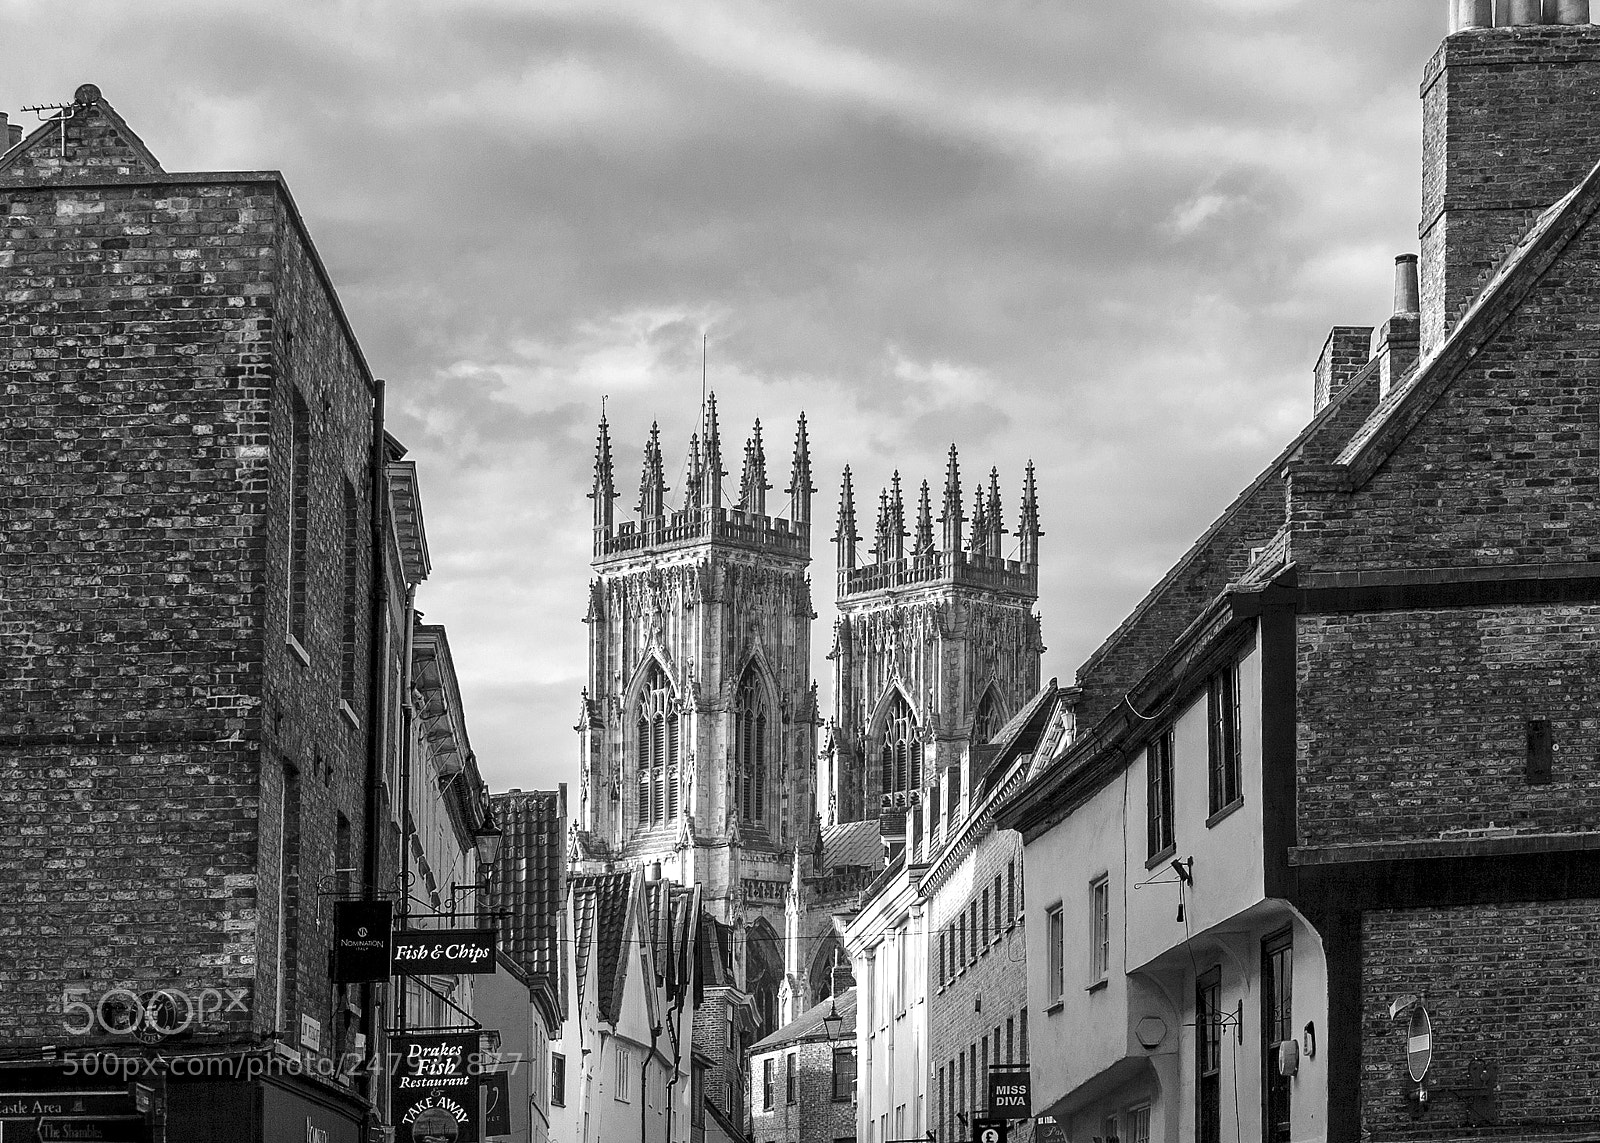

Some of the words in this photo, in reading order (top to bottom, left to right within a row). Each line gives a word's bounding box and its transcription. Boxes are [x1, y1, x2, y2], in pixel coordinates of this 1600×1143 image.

[395, 944, 429, 960] Fish
[430, 944, 444, 960] &
[445, 943, 490, 963] Chips
[407, 1042, 463, 1058] Drakes
[415, 1058, 456, 1076] Fish
[399, 1075, 470, 1089] Restaurant
[996, 1085, 1027, 1095] MISS
[0, 1099, 28, 1114] astle
[32, 1100, 62, 1113] Area
[996, 1096, 1026, 1106] DIVA
[402, 1096, 434, 1124] TAKE
[436, 1096, 470, 1124] AWAY
[43, 1124, 60, 1138] The
[62, 1123, 103, 1138] Shambles
